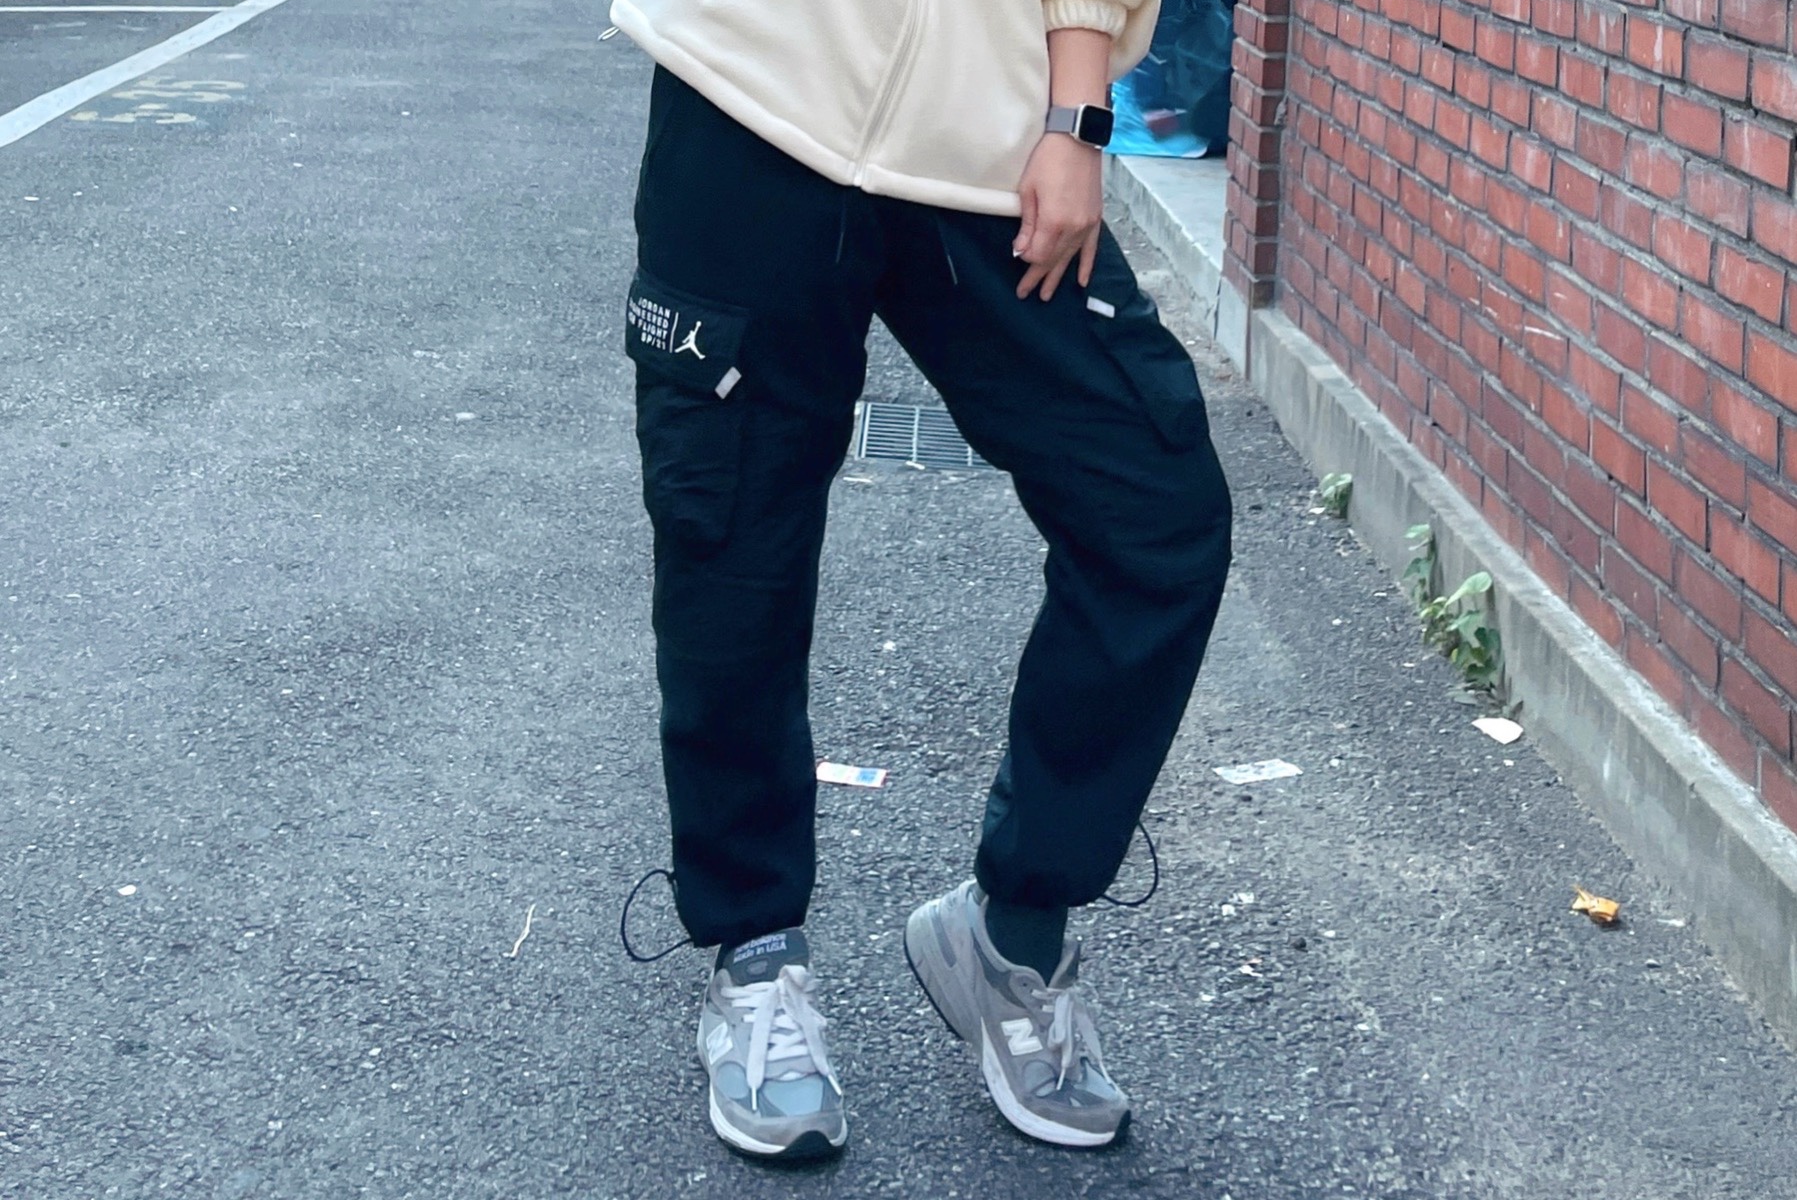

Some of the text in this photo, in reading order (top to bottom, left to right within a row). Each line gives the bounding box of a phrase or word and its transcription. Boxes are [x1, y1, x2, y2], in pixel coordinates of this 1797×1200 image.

[638, 296, 671, 318] JORDAN
[638, 319, 668, 339] FLIGHT
[641, 331, 666, 350] SP/21
[766, 940, 787, 953] USA
